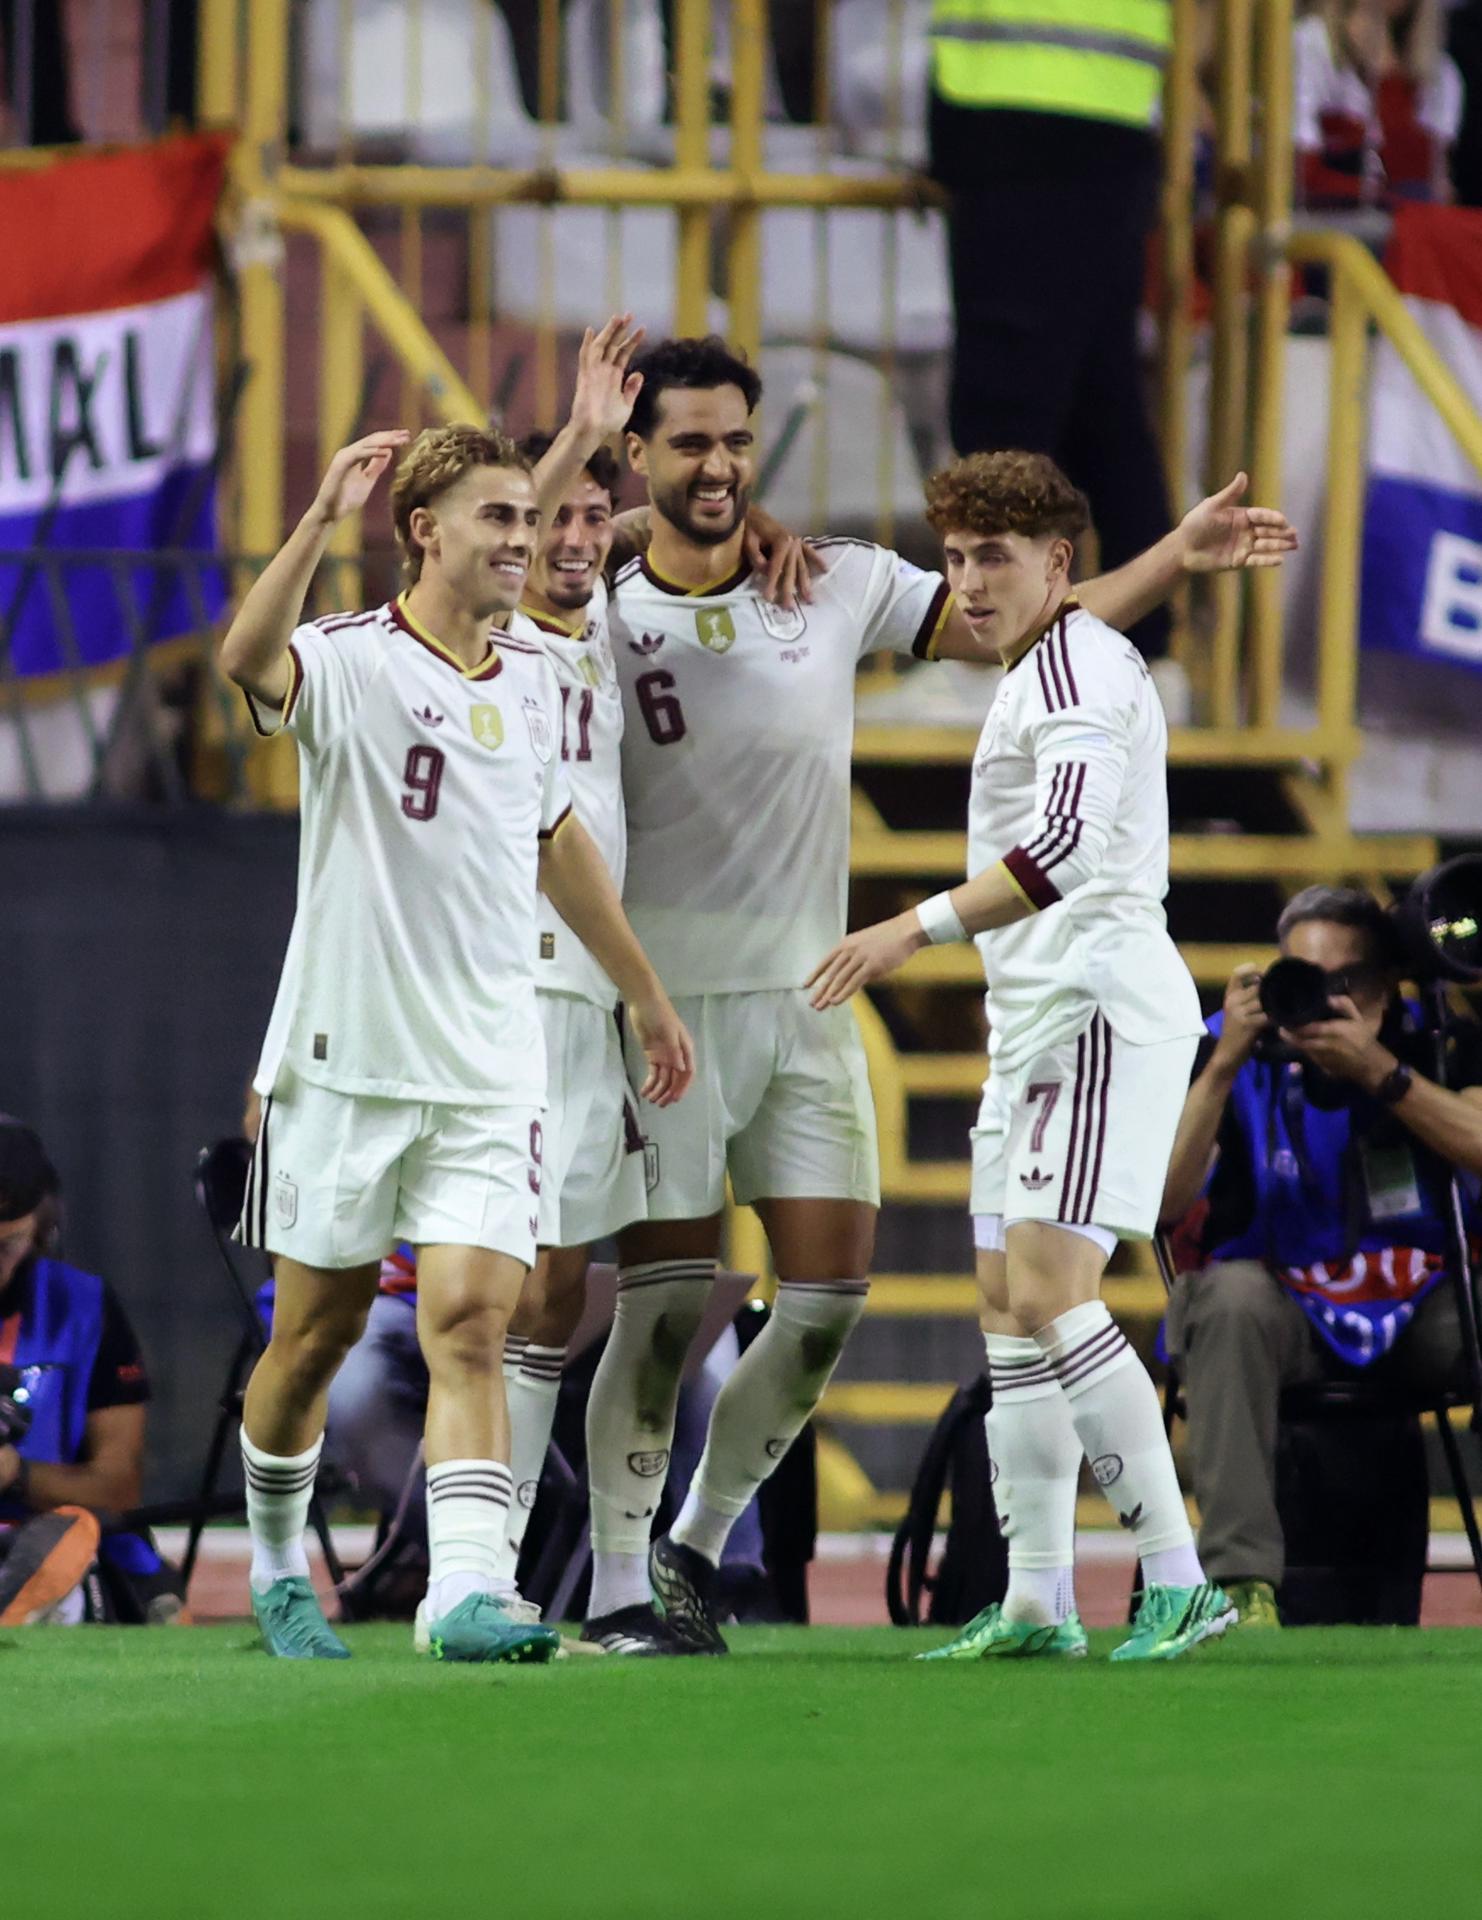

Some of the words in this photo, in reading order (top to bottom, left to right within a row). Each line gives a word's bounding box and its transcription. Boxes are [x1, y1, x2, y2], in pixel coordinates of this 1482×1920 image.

[560, 686, 593, 761] 11
[635, 668, 686, 746] 6
[402, 745, 445, 822] 9
[1026, 1082, 1062, 1152] 7
